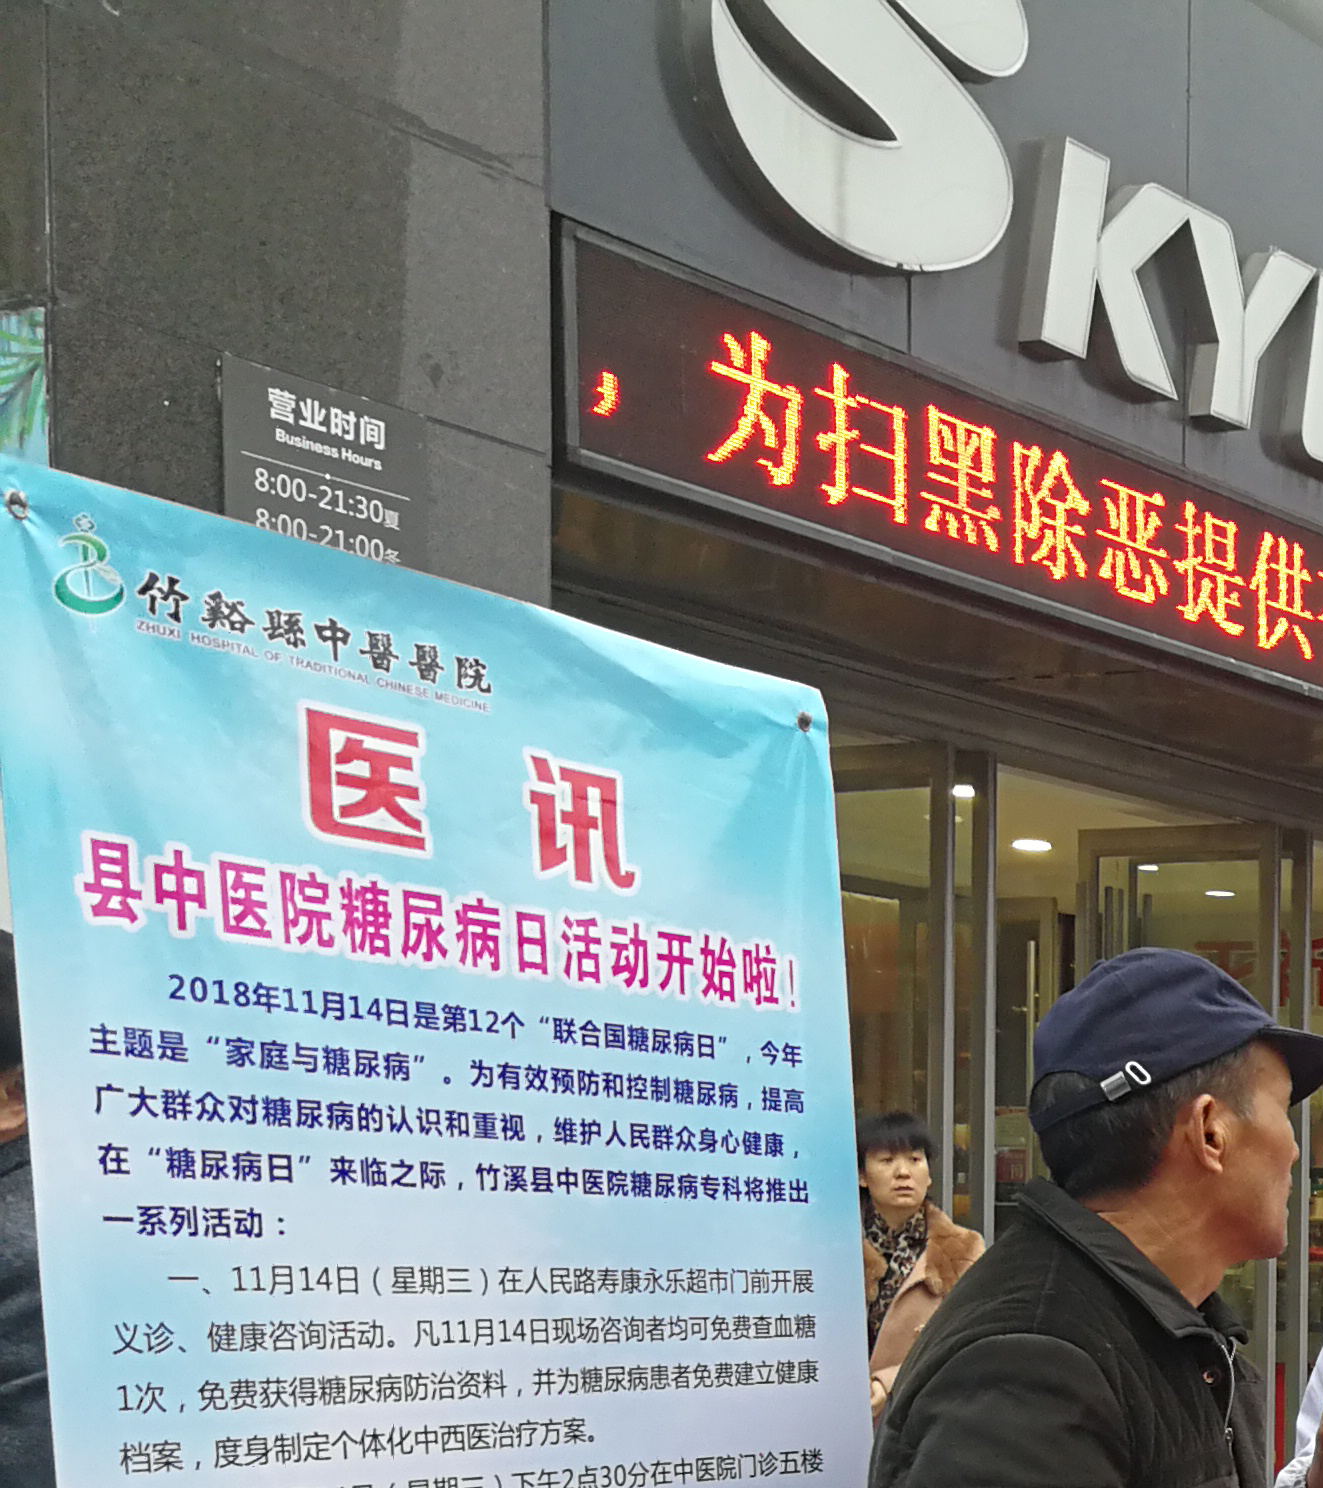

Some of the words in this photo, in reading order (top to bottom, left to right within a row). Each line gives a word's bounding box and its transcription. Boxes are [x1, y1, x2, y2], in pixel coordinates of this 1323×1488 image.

[267, 386, 386, 451] 营业时间
[274, 427, 339, 459] Business
[340, 448, 383, 471] Hours
[136, 619, 182, 641] ZHUXI
[190, 631, 260, 659] HOSPITAL
[264, 648, 282, 664] OF
[287, 654, 370, 684] TRADITIONAL
[376, 676, 430, 699] CHINESE
[434, 691, 491, 713] MEDICINE
[306, 707, 637, 889] 医讯
[102, 1205, 286, 1239] 一系列活动：
